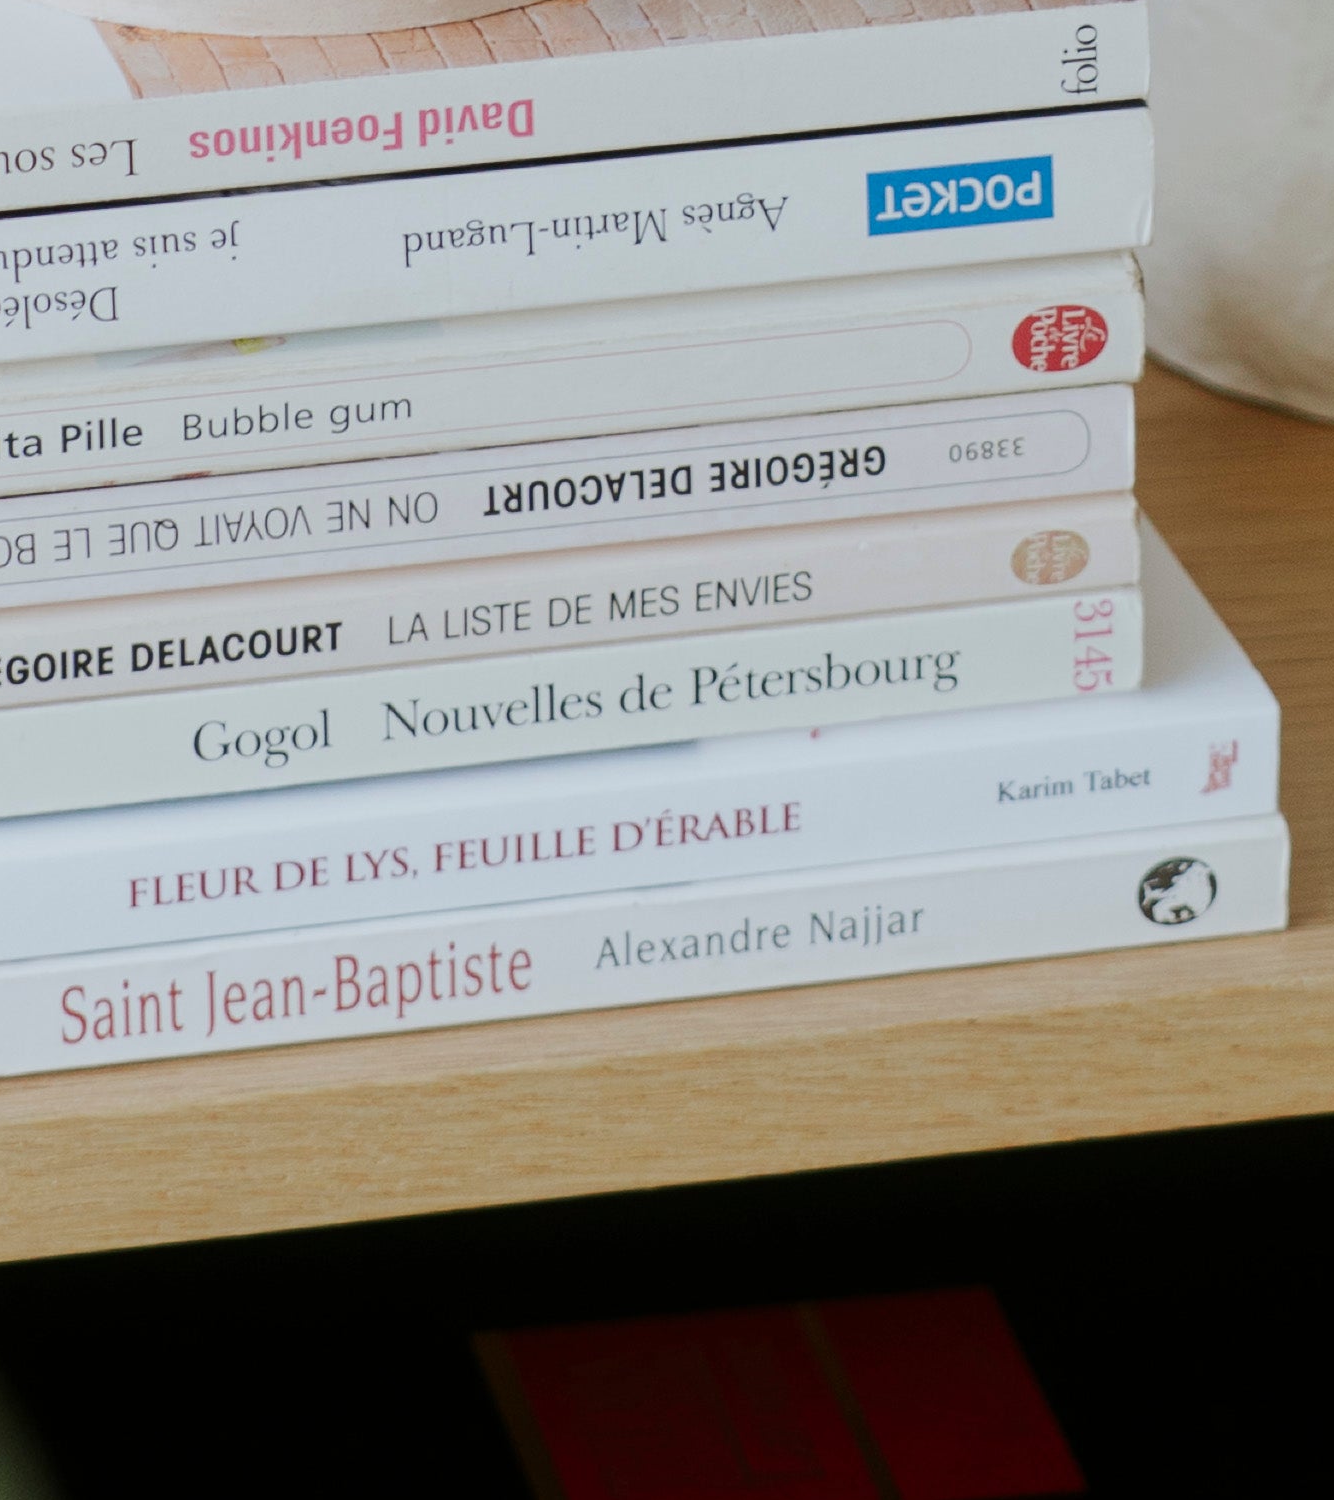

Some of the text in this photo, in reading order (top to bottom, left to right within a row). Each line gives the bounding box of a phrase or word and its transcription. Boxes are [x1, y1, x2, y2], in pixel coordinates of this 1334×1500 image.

[1061, 23, 1098, 94] folio
[72, 137, 139, 177] Les
[189, 97, 535, 163] David Foenkinos
[133, 230, 198, 270] suis
[211, 225, 240, 261] je
[401, 194, 789, 267] Agnès Martin-Lugand
[1030, 307, 1058, 372] Poche
[1060, 308, 1086, 369] Livre
[61, 420, 143, 455] Pille
[183, 394, 414, 441] Bubble gum
[949, 437, 1025, 463] 33890
[388, 491, 439, 526] ON
[483, 446, 886, 517] GRÉGOIRE DELACOURT
[108, 520, 178, 556] QUE
[194, 506, 311, 548] VOYAIT
[326, 498, 371, 531] NE
[54, 528, 91, 561] LE
[387, 571, 814, 645] LA LISTE DE MES ENVIES
[131, 621, 342, 673] DELACOURT
[1072, 599, 1114, 693] 3145
[381, 648, 961, 743] Nouvelles de Pétersbourg
[192, 709, 331, 768] Gogol
[997, 765, 1151, 805] Karim Tabet
[129, 802, 802, 909] FLEUR DE LYS, FEUILLE D'ÉRABLE
[595, 904, 925, 970] Alexandre Najjar
[61, 940, 533, 1046] Saint Jean-Baptiste
